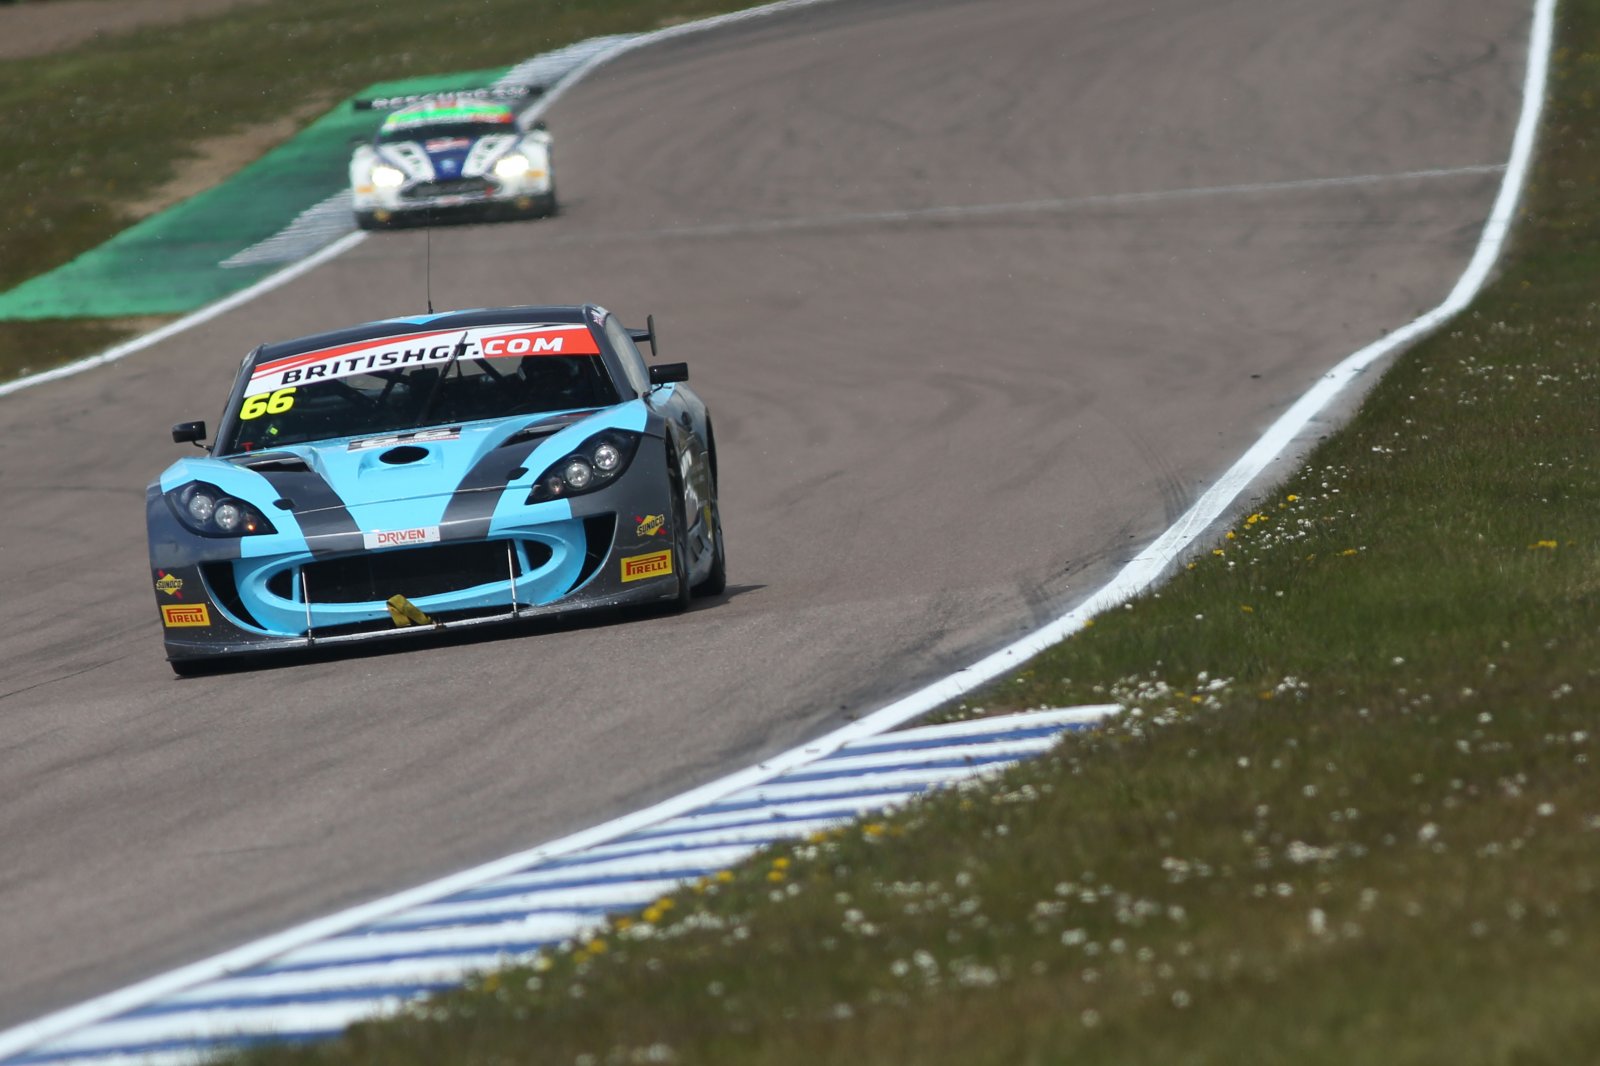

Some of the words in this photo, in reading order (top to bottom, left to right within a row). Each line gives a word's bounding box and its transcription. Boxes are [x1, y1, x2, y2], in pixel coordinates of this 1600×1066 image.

[281, 337, 563, 385] BRITISHGT.COM
[240, 387, 296, 420] 66
[638, 515, 664, 535] SUNOCO
[378, 530, 425, 544] DRIVEN
[627, 555, 667, 576] PIRELLI
[157, 579, 182, 589] SUNOCO
[166, 608, 205, 624] PIRELLI
